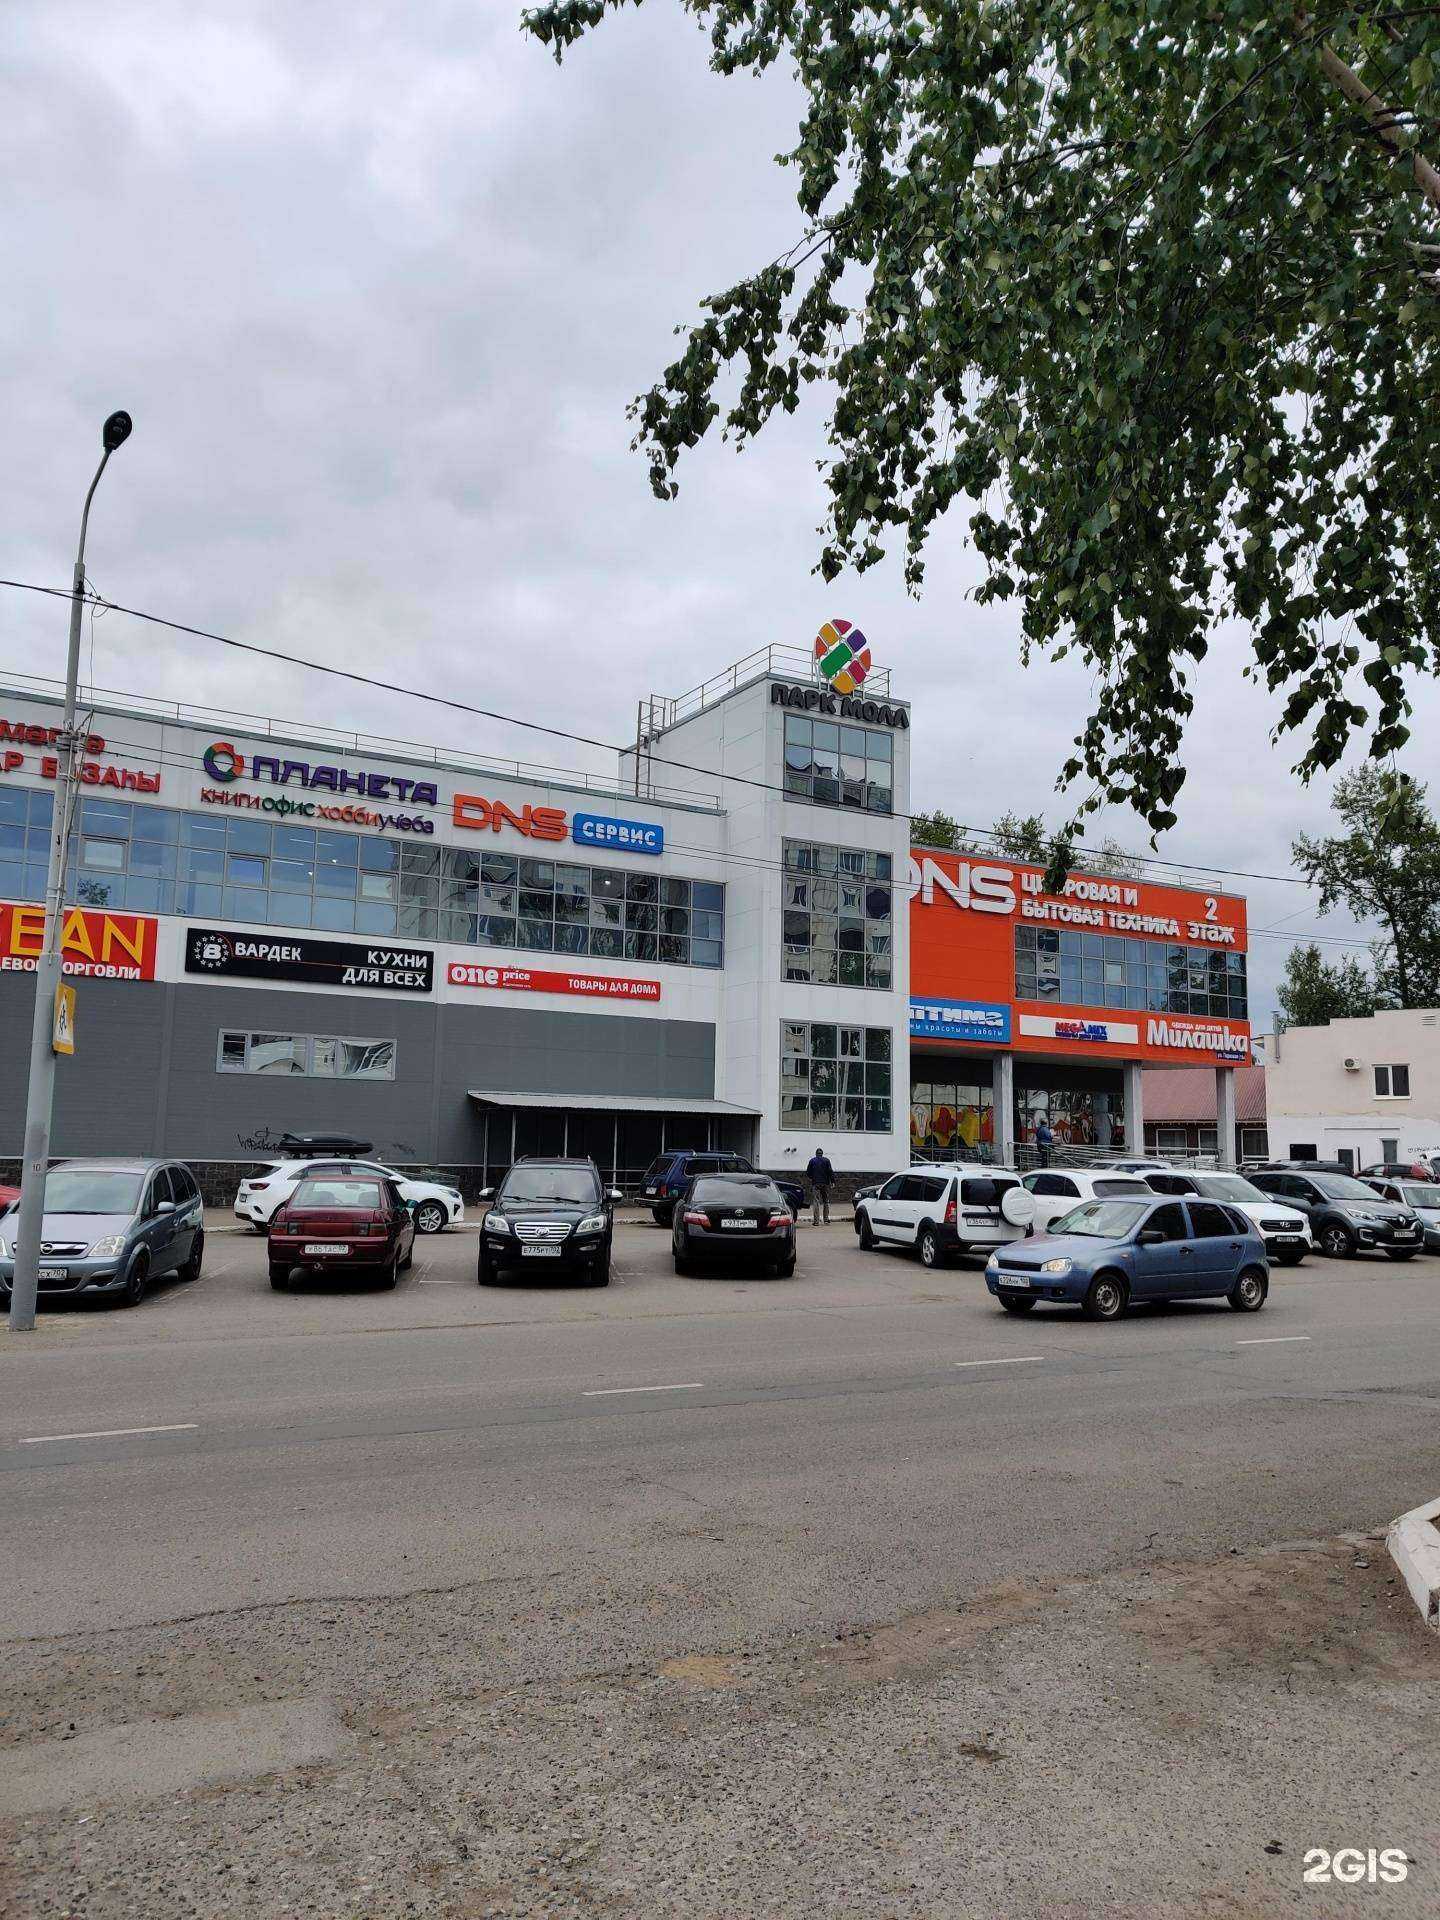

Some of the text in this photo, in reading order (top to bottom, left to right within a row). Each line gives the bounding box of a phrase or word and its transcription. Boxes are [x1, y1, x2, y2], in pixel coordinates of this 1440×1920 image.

[771, 683, 910, 729] ПАРК МОЛЛ
[41, 756, 161, 793] БЗАҺЫ
[252, 755, 438, 806] ПЛАНЕТА
[261, 795, 315, 818] офис
[453, 793, 568, 842] DNS
[582, 821, 656, 846] СЕРВИС
[910, 855, 1017, 914] NS
[1021, 873, 1138, 906] ЦРОВАЯ И
[1021, 898, 1181, 937] БЫТОВАЯ ТЕХНИКА
[1204, 897, 1218, 921] 2
[0, 905, 145, 966] EAN
[234, 942, 301, 962] ВАРДЕК
[367, 950, 428, 969] КУХНИ
[61, 961, 141, 980] ОРГОВЛИ
[342, 968, 427, 987] ДЛЯ ВСЕХ
[451, 966, 531, 985] one price
[568, 978, 657, 995] ТОВАРЫ ДЛЯ ДОМА
[1147, 1019, 1248, 1053] Милашка
